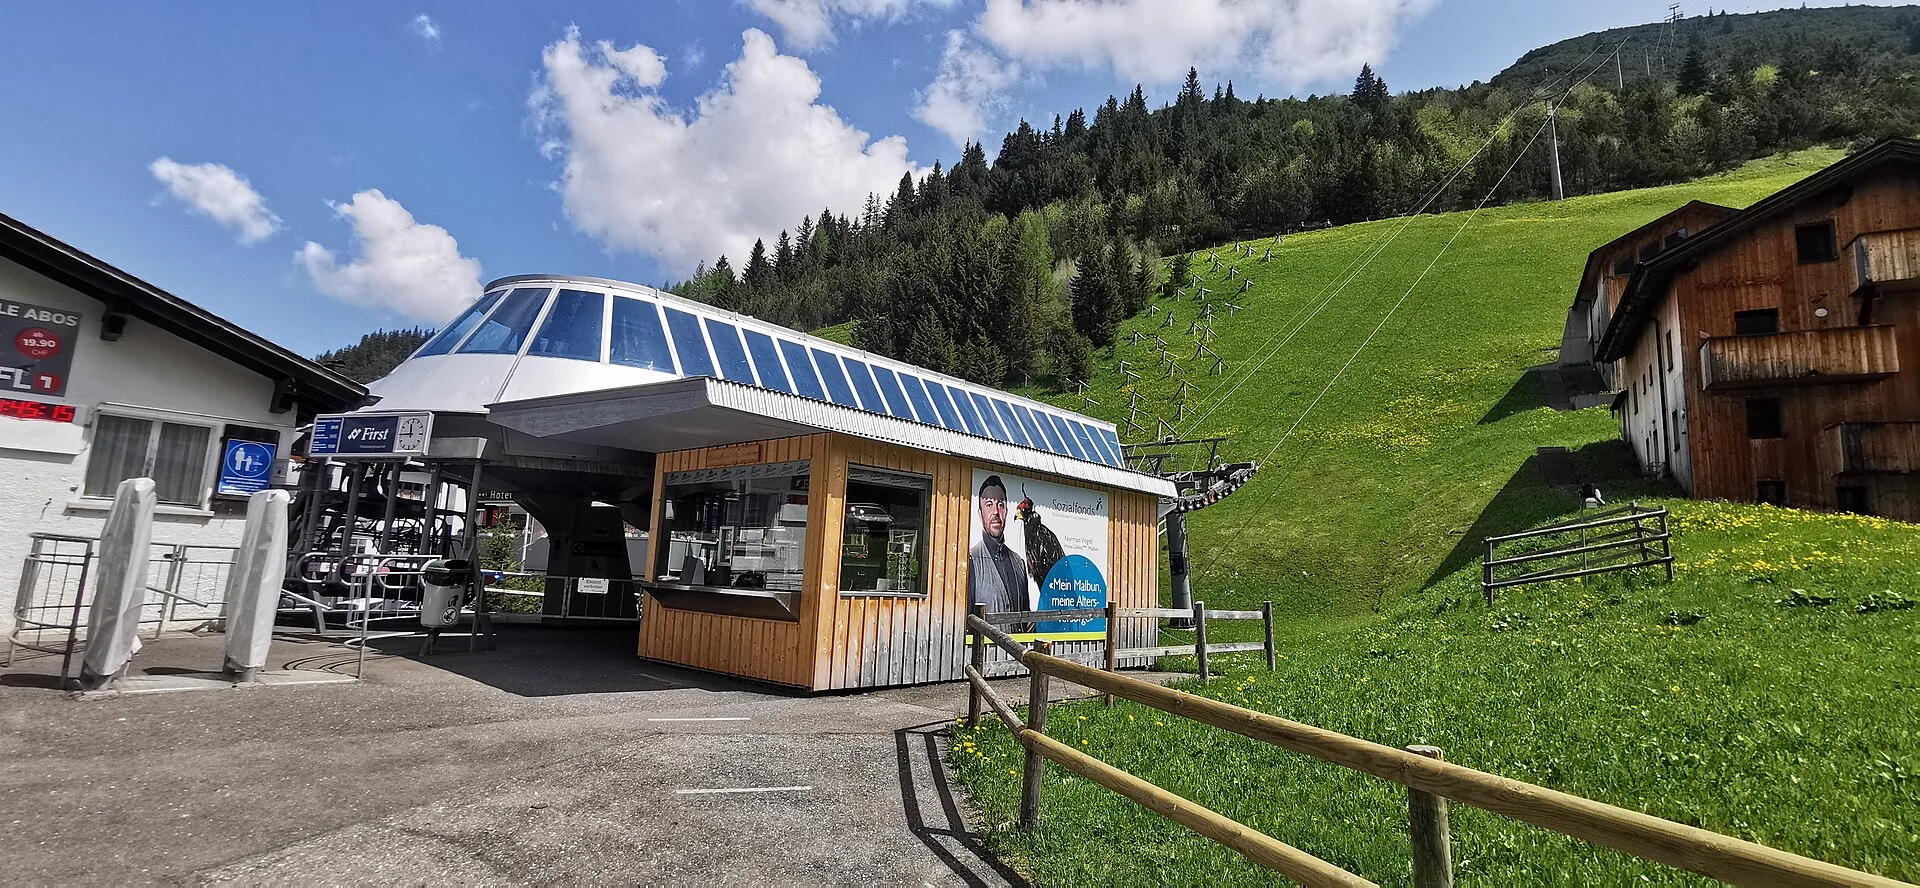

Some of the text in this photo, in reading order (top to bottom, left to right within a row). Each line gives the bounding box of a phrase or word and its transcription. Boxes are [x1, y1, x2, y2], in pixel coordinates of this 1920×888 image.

[23, 308, 77, 326] ABOS
[22, 338, 56, 348] 19.90
[361, 427, 389, 441] First
[1052, 498, 1096, 516] Sozialfonds
[1049, 577, 1102, 593] «Mein Malbun,
[1051, 594, 1100, 607] meine Alters-
